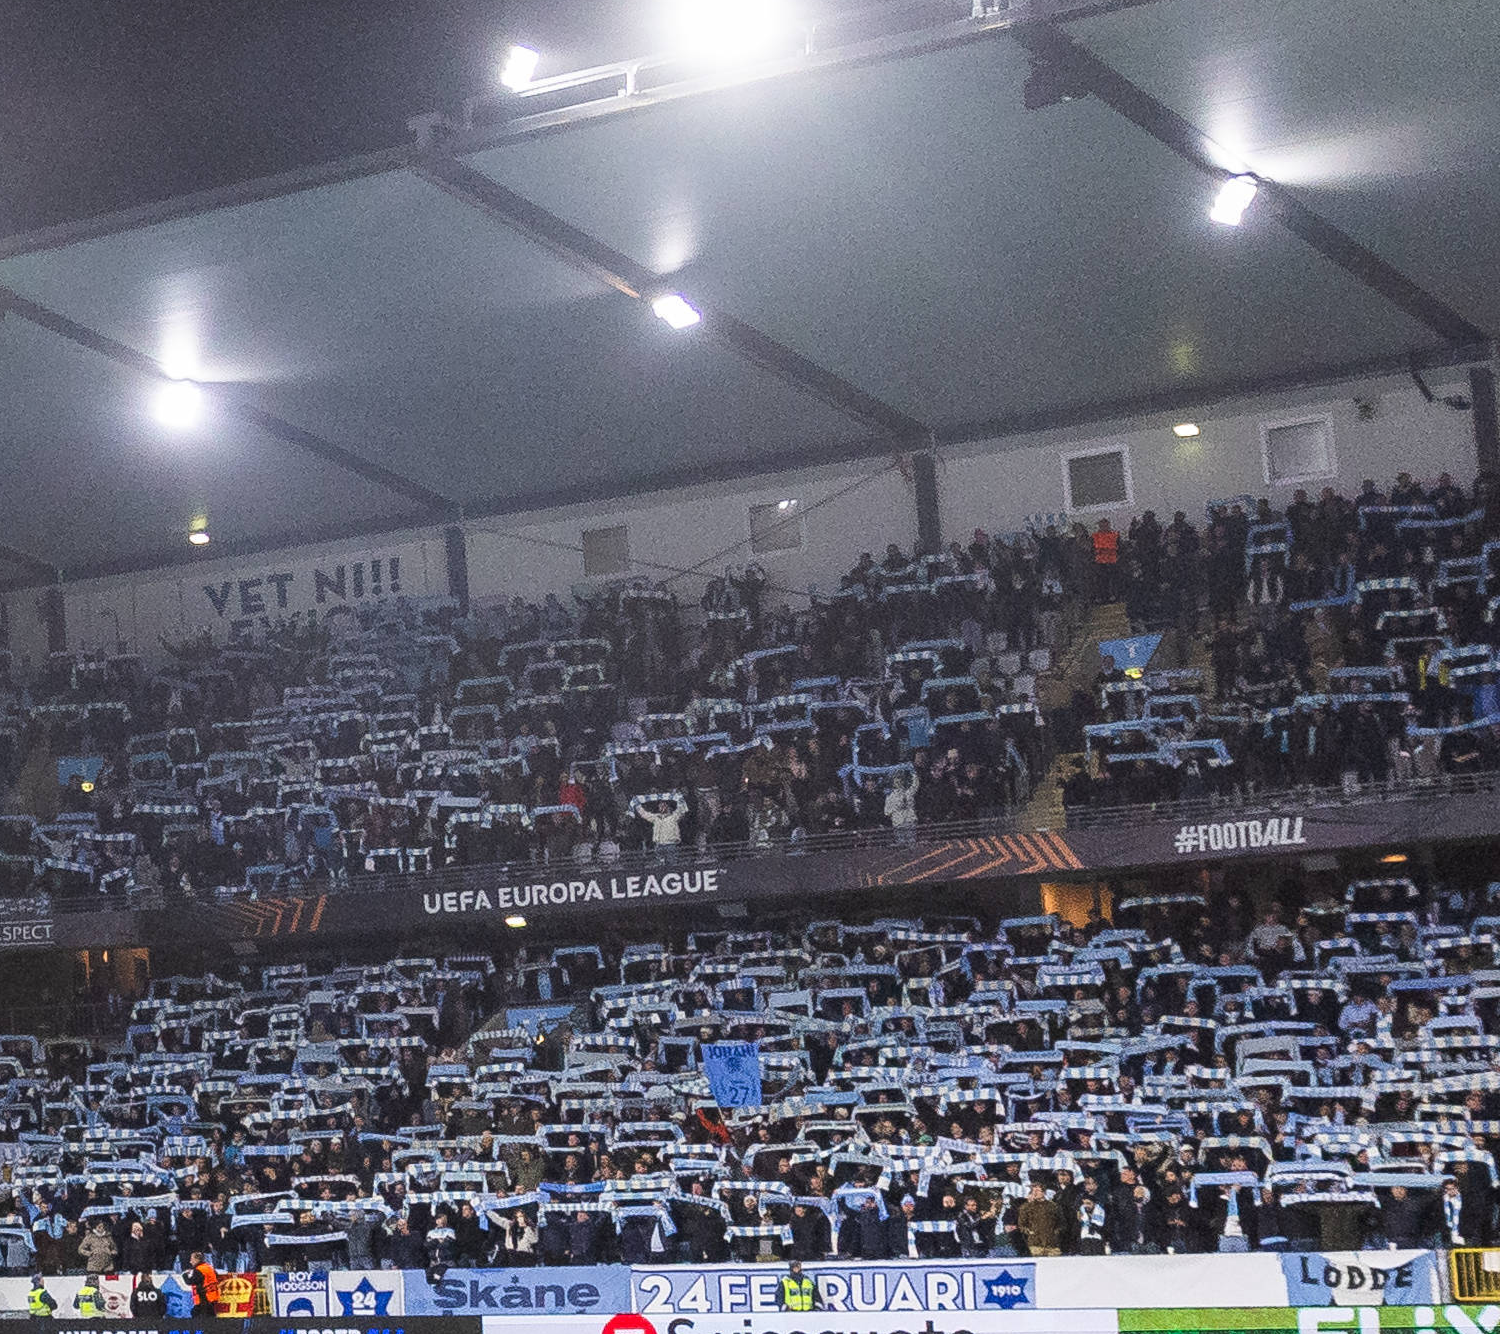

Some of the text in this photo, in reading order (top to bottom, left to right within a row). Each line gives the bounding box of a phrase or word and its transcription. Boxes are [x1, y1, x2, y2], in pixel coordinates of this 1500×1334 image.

[203, 571, 294, 617] VET
[1174, 817, 1307, 854] #FOOTBALL
[423, 869, 719, 915] UEFA EUROPA LEAGUE
[275, 1279, 328, 1293] HODGSON
[288, 1270, 314, 1283] ROY
[991, 1283, 1022, 1297] 1910
[1300, 1256, 1414, 1291] LODDE
[136, 1290, 159, 1303] SLO
[350, 1290, 376, 1308] 24
[432, 1274, 601, 1310] Skåne
[638, 1270, 976, 1313] 24 FERUARI
